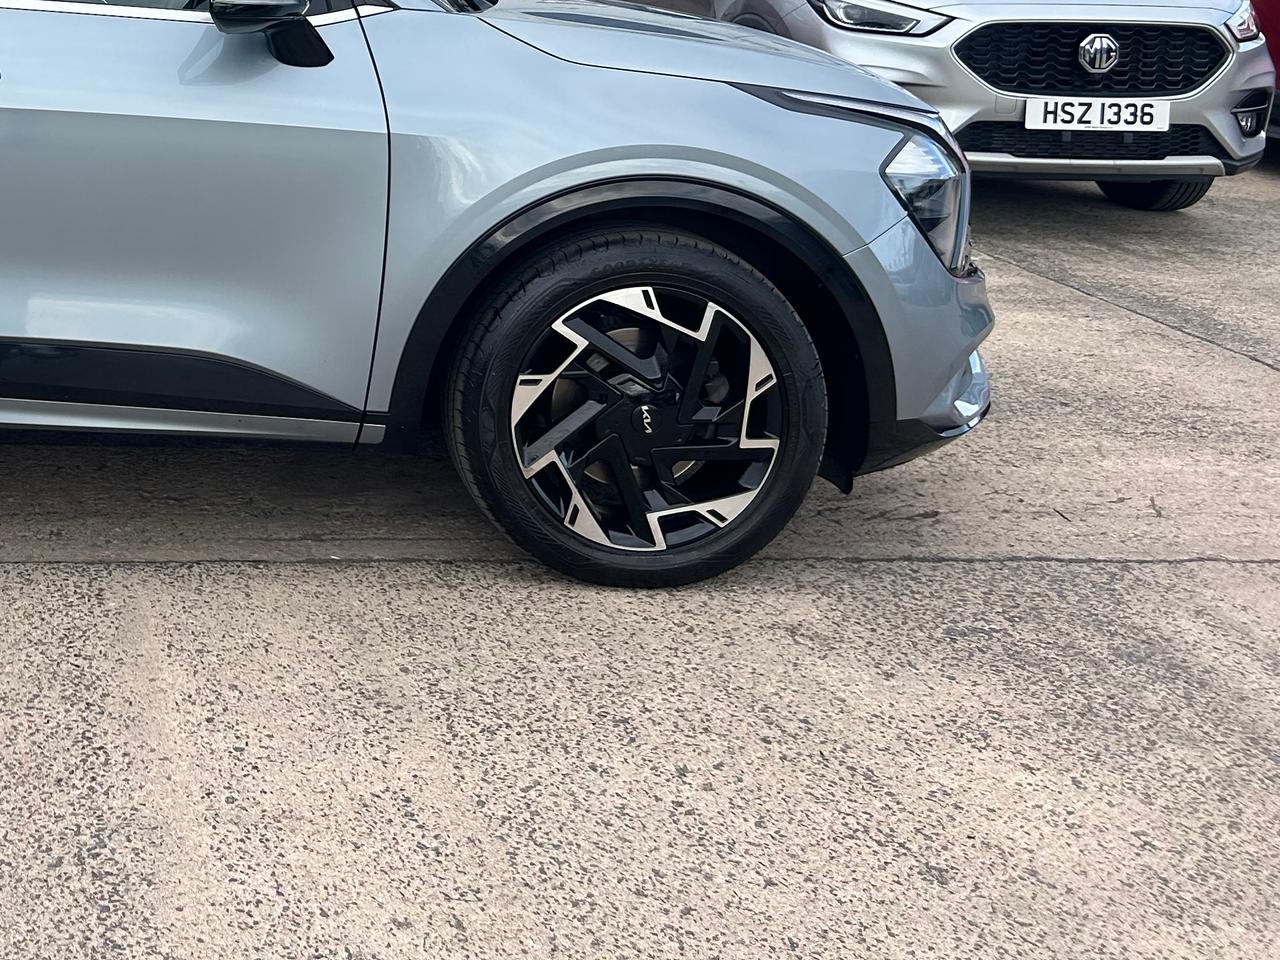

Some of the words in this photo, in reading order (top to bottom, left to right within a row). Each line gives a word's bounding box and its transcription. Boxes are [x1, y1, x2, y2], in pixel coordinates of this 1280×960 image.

[1082, 35, 1118, 71] MG
[1042, 101, 1093, 125] HSZ
[1099, 102, 1155, 126] 1336
